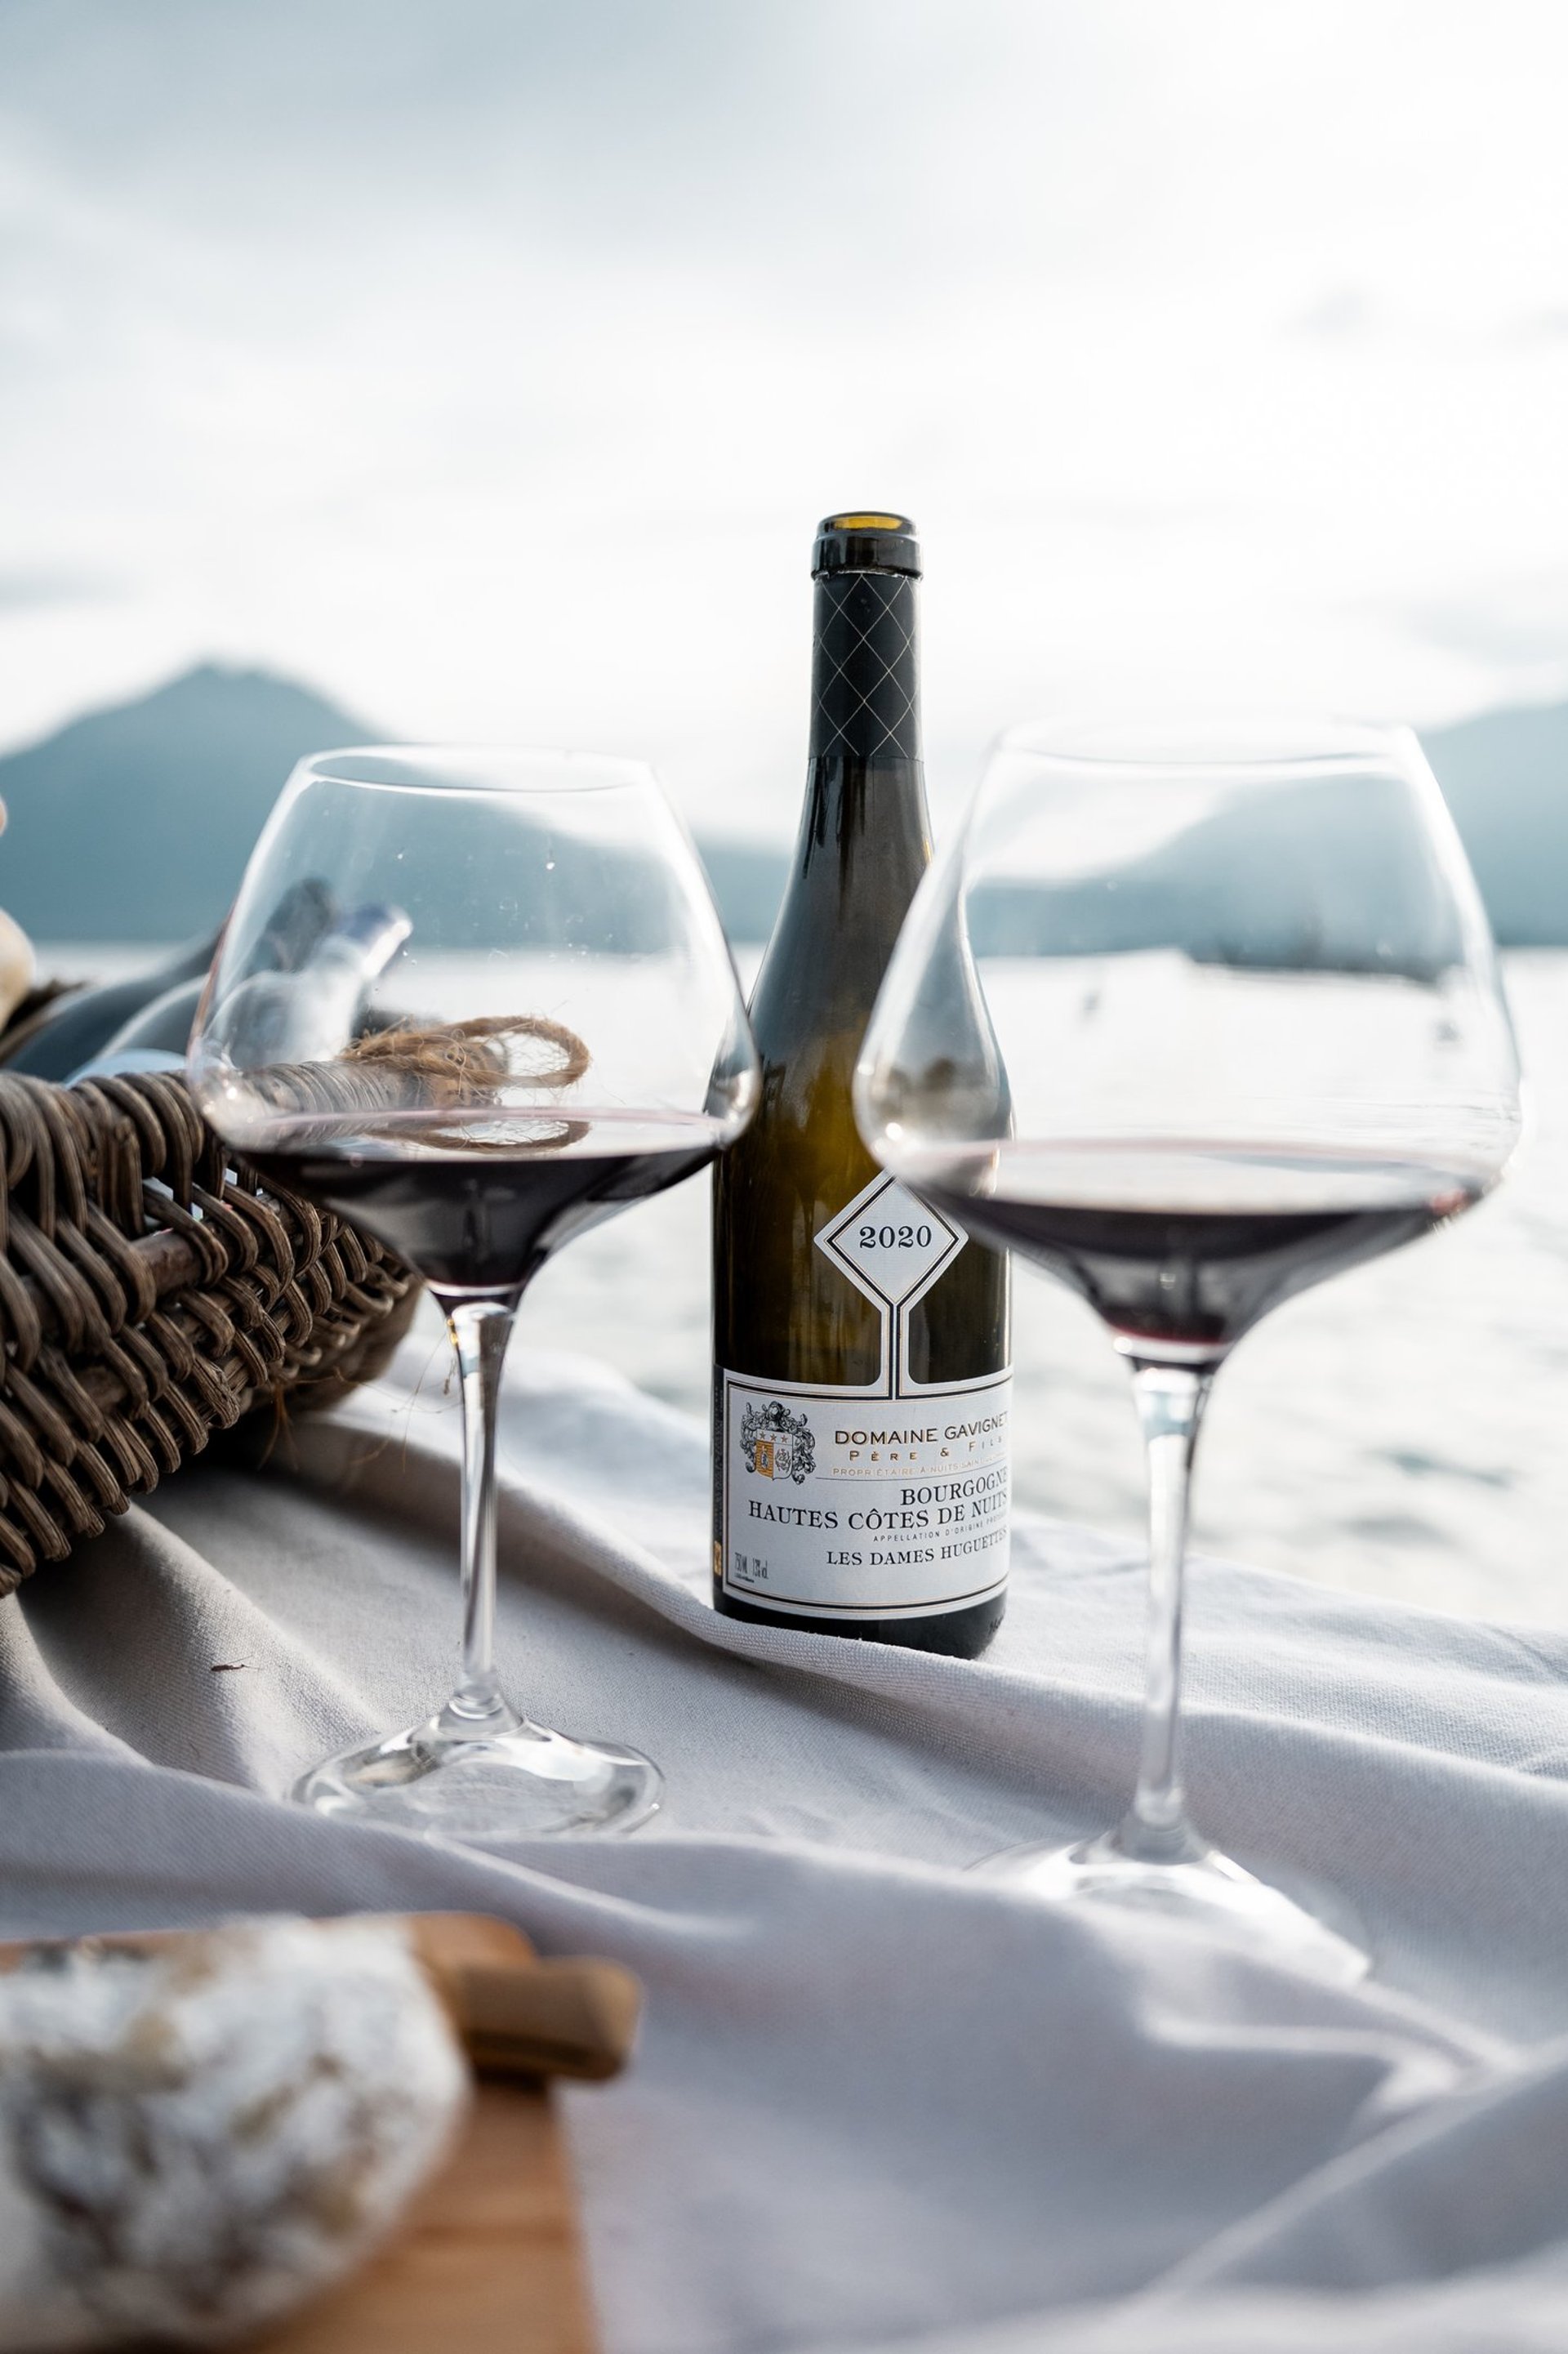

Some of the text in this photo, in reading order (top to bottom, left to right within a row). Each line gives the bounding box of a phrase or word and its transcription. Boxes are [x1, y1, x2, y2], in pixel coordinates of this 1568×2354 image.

[859, 1225, 932, 1248] 2020
[835, 1411, 1008, 1445] DOMAINE GAVIGNET
[849, 1436, 1002, 1461] PÈRE & FILS
[900, 1466, 1008, 1506] BOURGOGNE
[748, 1500, 838, 1529] HAUTES
[848, 1508, 929, 1530] CÔTES
[938, 1505, 965, 1525] DE
[972, 1487, 1008, 1518] NUITS
[873, 1531, 940, 1542] APPELLATION
[826, 1551, 862, 1566] LES
[869, 1548, 935, 1566] DAMES
